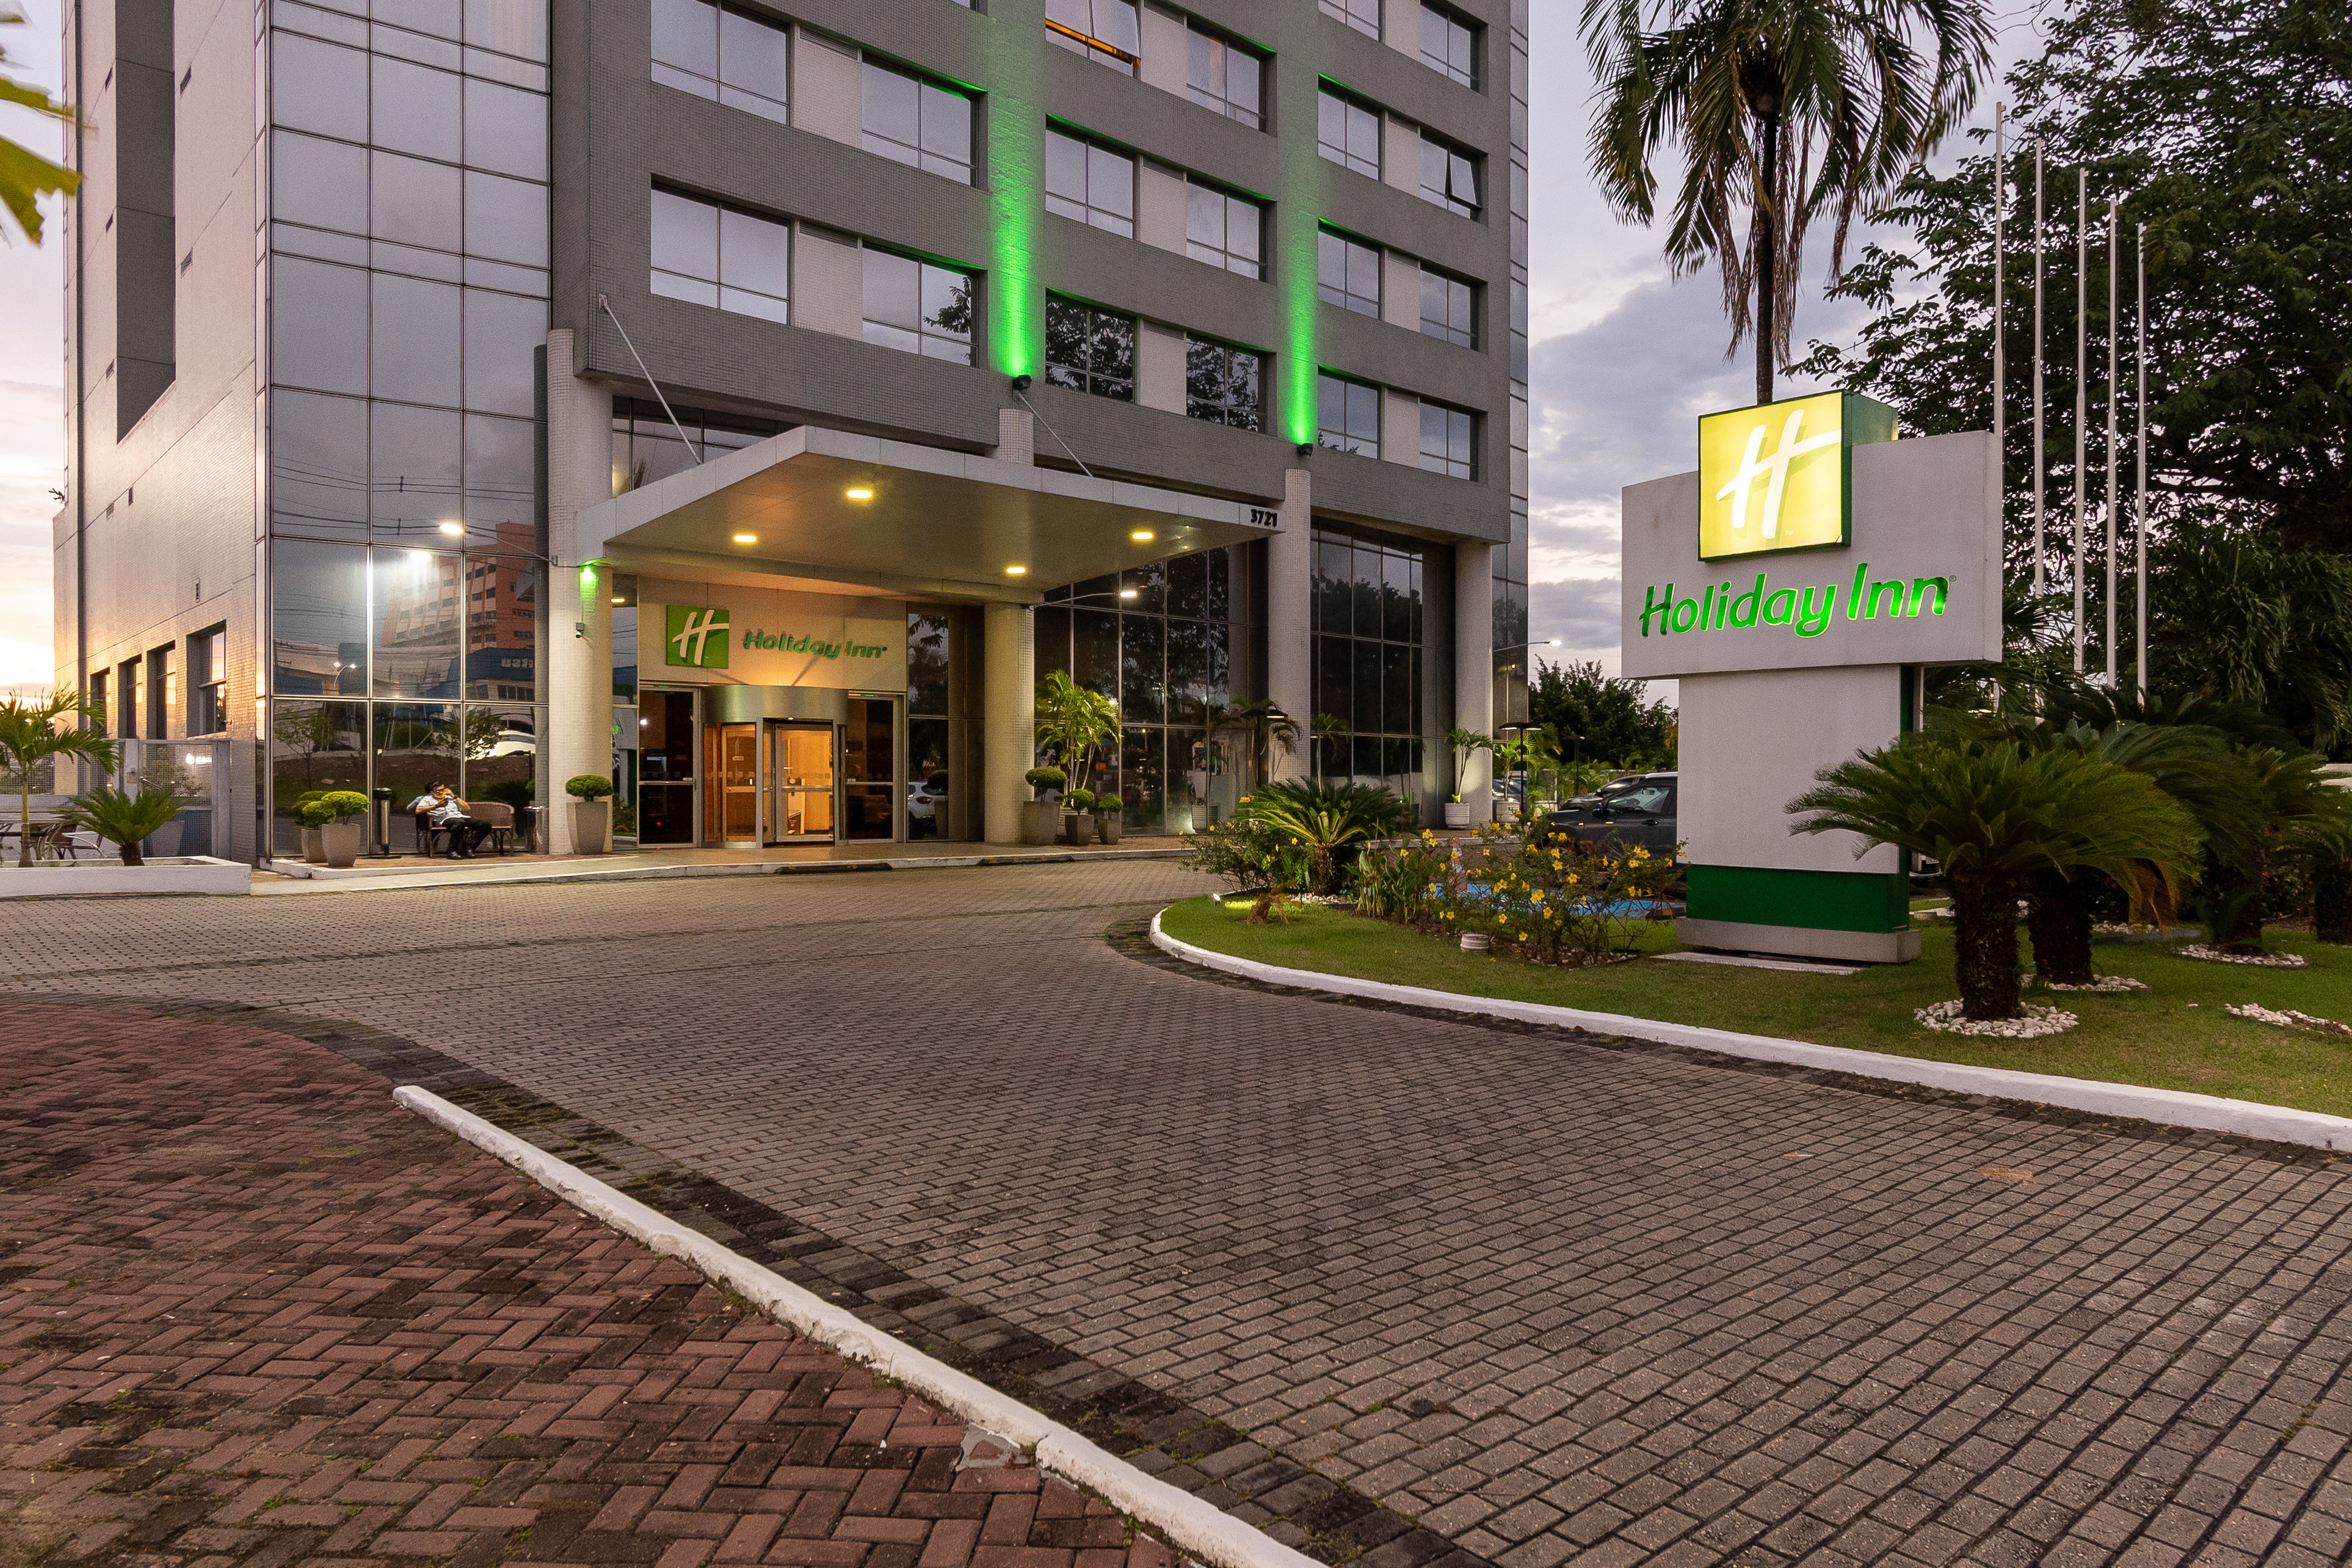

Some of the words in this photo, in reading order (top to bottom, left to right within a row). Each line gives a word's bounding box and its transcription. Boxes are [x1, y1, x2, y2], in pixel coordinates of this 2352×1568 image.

[1716, 409, 1842, 539] H
[1250, 509, 1278, 527] 3721
[1639, 573, 1838, 638] Holiday
[1847, 563, 1949, 620] Inn
[672, 609, 729, 666] H
[743, 631, 841, 659] Holiday
[845, 641, 882, 658] Inn
